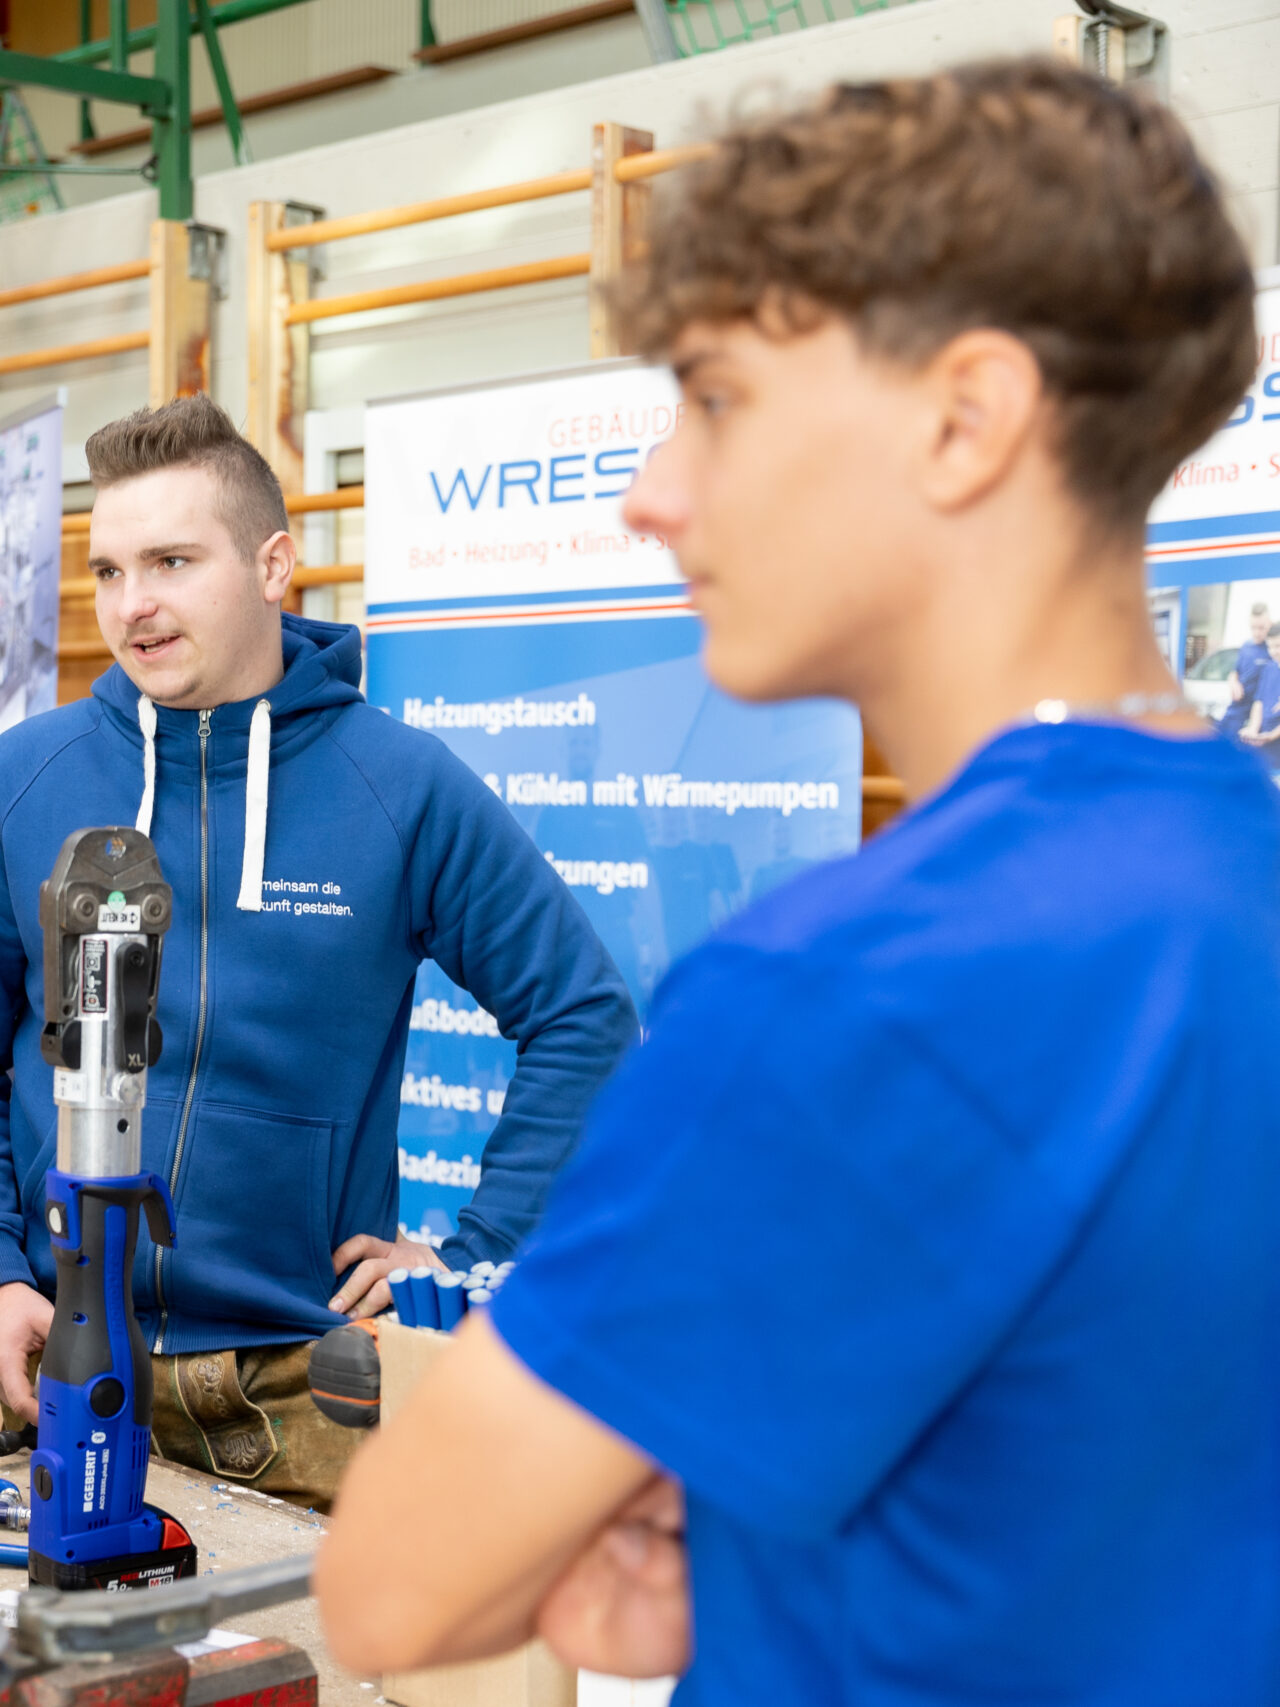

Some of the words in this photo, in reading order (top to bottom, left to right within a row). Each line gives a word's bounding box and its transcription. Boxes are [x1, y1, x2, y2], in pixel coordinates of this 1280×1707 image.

[569, 531, 631, 556] Klima
[403, 694, 596, 735] Heizungstausch
[506, 772, 588, 807] Kühlen
[592, 773, 639, 807] mit
[641, 773, 840, 817] Wärmepumpen
[322, 882, 342, 895] die
[294, 902, 353, 917] gestalten.
[128, 1053, 144, 1067] XL
[84, 1450, 96, 1501] GEBERIT
[120, 1565, 175, 1582] REDLITHIUM
